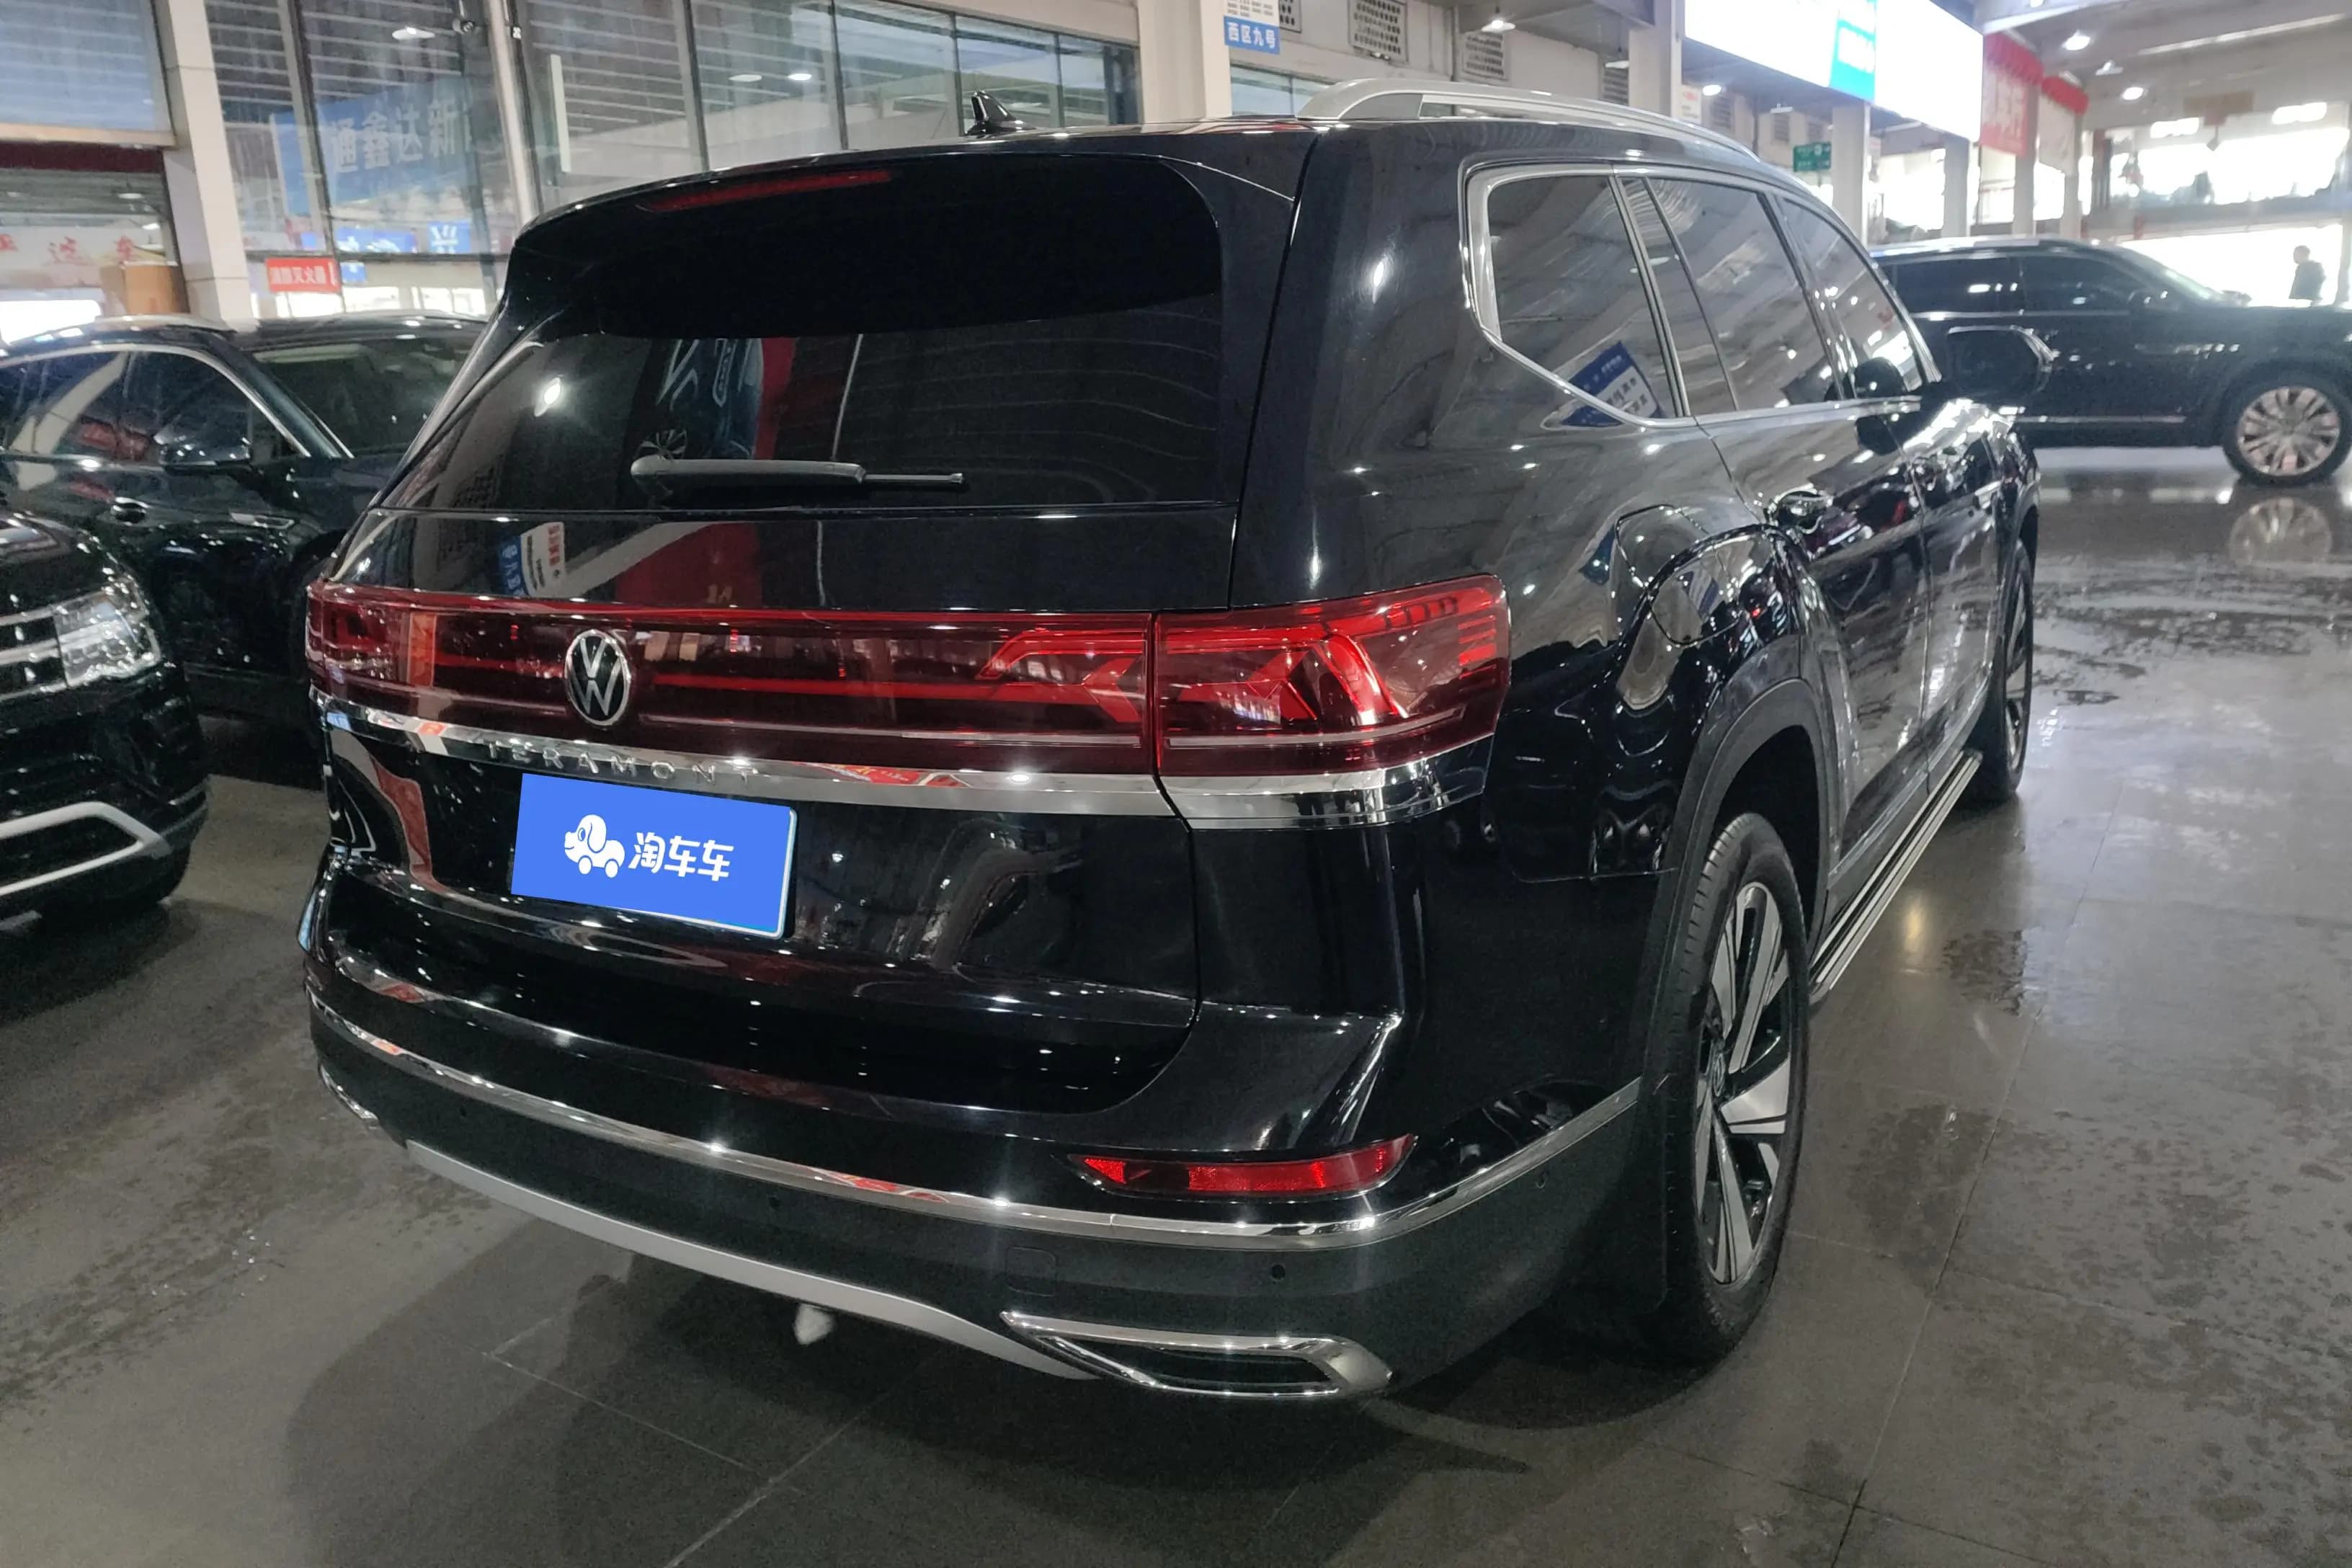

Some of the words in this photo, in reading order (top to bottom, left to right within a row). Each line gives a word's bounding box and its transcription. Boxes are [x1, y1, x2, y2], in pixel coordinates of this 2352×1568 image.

[1226, 22, 1276, 49] 西区九号
[483, 739, 758, 784] TERAMONT
